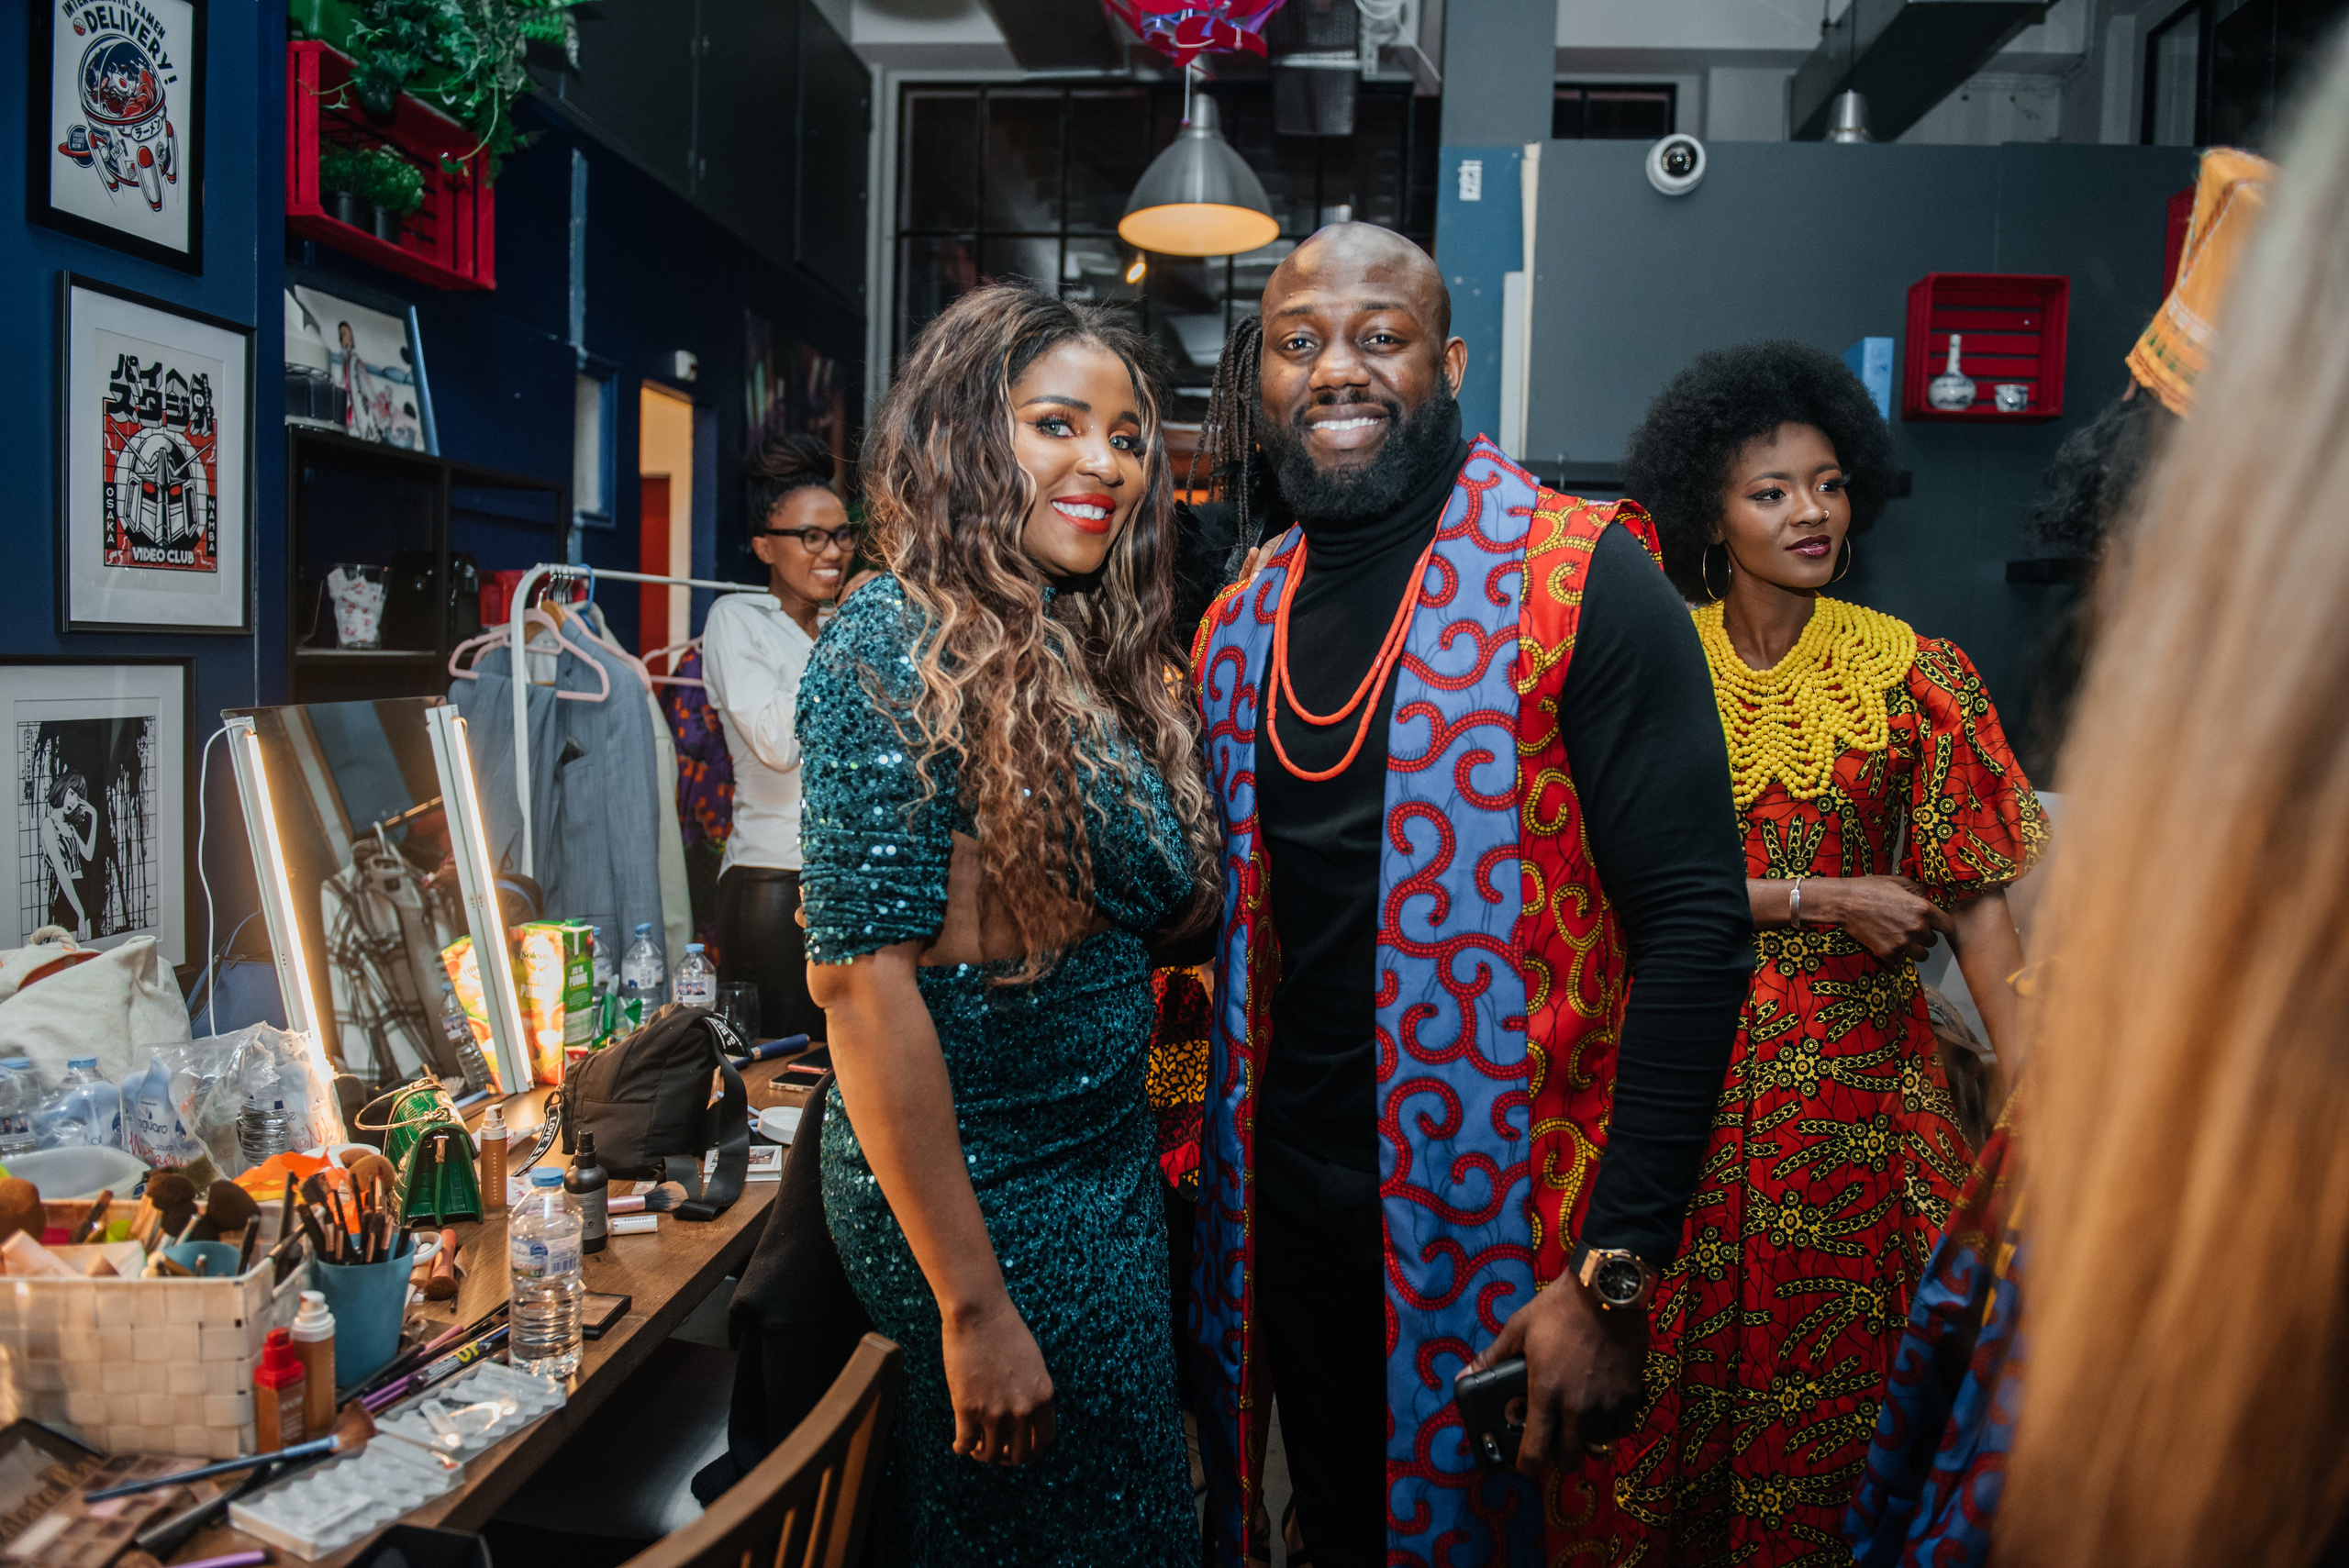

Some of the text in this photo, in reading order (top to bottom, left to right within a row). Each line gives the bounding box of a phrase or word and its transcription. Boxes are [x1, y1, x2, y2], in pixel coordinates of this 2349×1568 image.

[134, 1, 166, 39] RAMEN
[83, 6, 178, 85] DELIVERY!
[135, 118, 161, 139] ラーメン
[106, 486, 115, 543] OSAKA
[131, 546, 195, 565] VIDEO CLUB
[569, 972, 588, 988] POMME
[541, 1116, 557, 1143] LOVE
